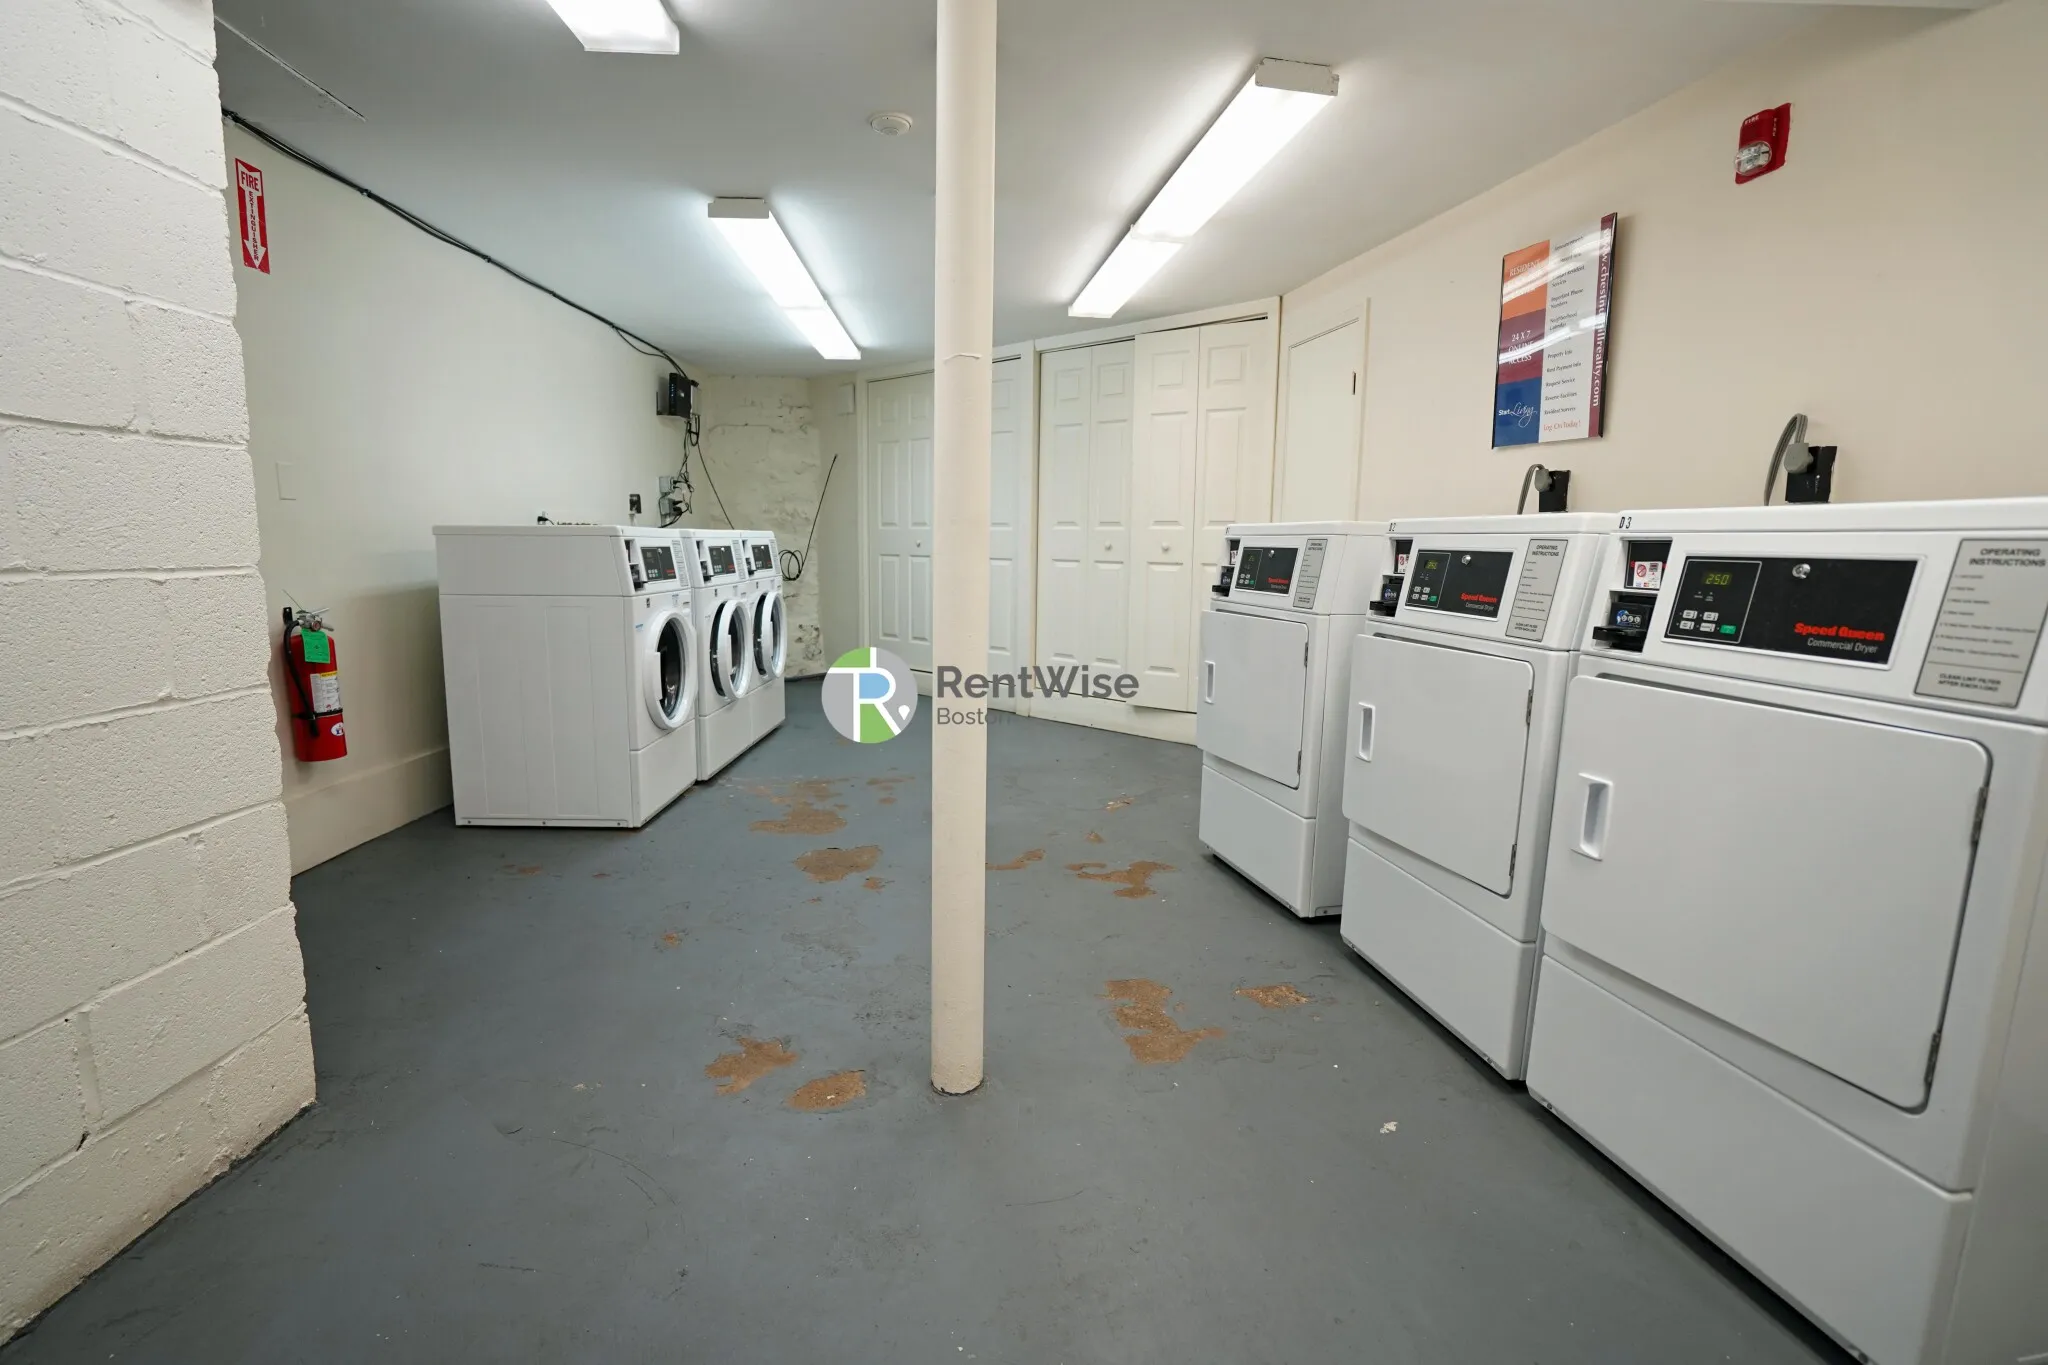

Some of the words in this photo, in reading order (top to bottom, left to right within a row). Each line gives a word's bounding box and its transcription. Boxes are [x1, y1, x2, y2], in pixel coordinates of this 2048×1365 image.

[240, 170, 260, 192] FIRE
[248, 190, 259, 261] EXTINGUISHER
[1511, 333, 1519, 342] 24
[1526, 330, 1531, 338] 7
[1498, 408, 1511, 416] Start
[1510, 402, 1538, 428] Living
[1543, 423, 1553, 432] Log
[1980, 547, 2042, 557] OPERATING
[1968, 557, 2047, 567] INSTRUCTIONS
[1704, 573, 1730, 586] 250
[1793, 621, 1838, 636] Speed
[1838, 625, 1886, 642] Queen
[1807, 637, 1854, 651] Commercial
[1854, 642, 1879, 654] Dryer
